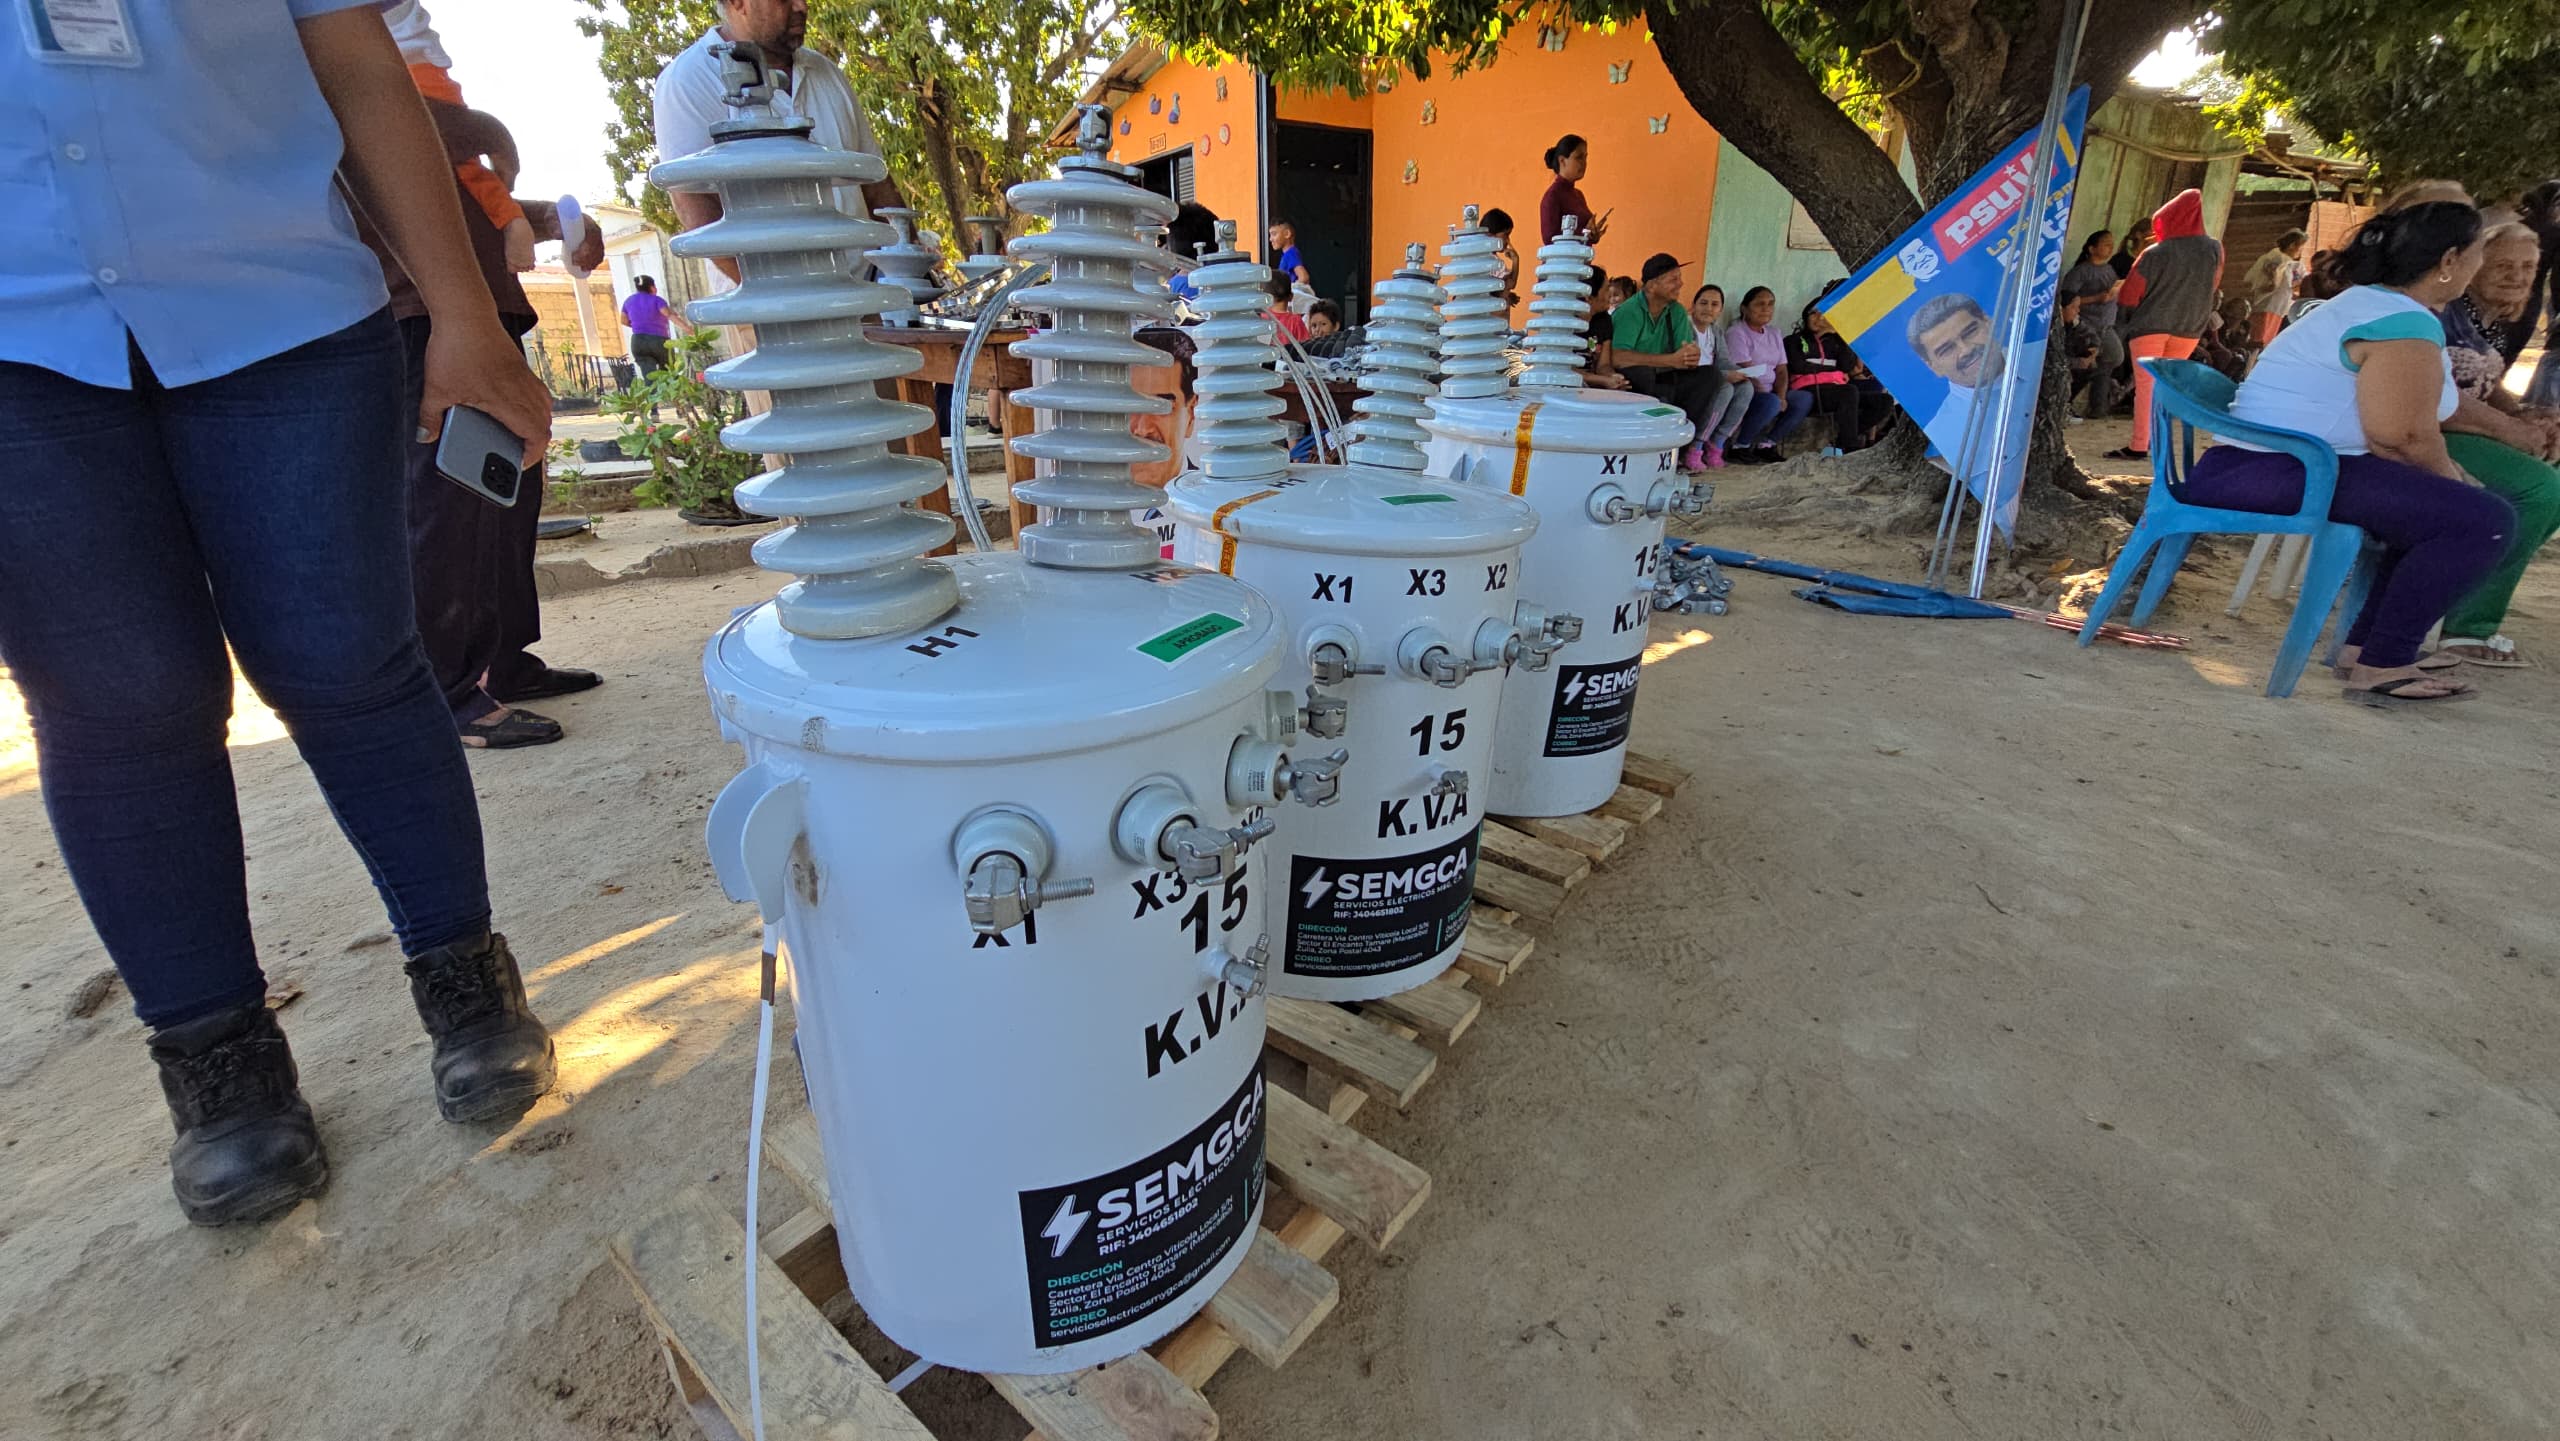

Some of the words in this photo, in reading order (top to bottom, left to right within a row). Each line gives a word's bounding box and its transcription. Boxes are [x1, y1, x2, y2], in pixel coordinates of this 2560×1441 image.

[1986, 238, 2009, 256] La
[1600, 455, 1628, 475] X1
[1657, 452, 1673, 473] X3
[1265, 478, 1308, 488] H1
[1634, 543, 1660, 577] 15
[1311, 572, 1353, 603] X1
[1406, 568, 1446, 596] X3
[1484, 563, 1507, 592] X2
[905, 626, 980, 657] H1
[1410, 708, 1467, 756] 15
[1336, 847, 1467, 900] SEMGCA
[1180, 863, 1248, 954] 15
[1333, 900, 1385, 909] SERVICIOS
[1333, 910, 1352, 919] RIF:
[1297, 923, 1348, 933] DIRECCIÓN
[1297, 932, 1333, 941] Carretera
[1097, 1072, 1264, 1230] SEMGCA
[1096, 1205, 1171, 1244] SERVICIOS
[1099, 1239, 1126, 1256] RIF:
[1128, 1197, 1199, 1245] J404651802
[1048, 1280, 1104, 1299] Carretera
[1126, 1252, 1163, 1277] Centro
[1199, 1209, 1220, 1231] Local
[1047, 1260, 1123, 1289] DIRECCIÓN
[1049, 1294, 1088, 1309] Sector
[1090, 1287, 1102, 1300] El
[1104, 1267, 1150, 1296] Encanto
[1151, 1246, 1188, 1273] Tamare
[1084, 1295, 1114, 1310] Zona
[1115, 1278, 1149, 1301] Postal
[1151, 1262, 1177, 1282] 4043
[1050, 1307, 1107, 1329] CORREO
